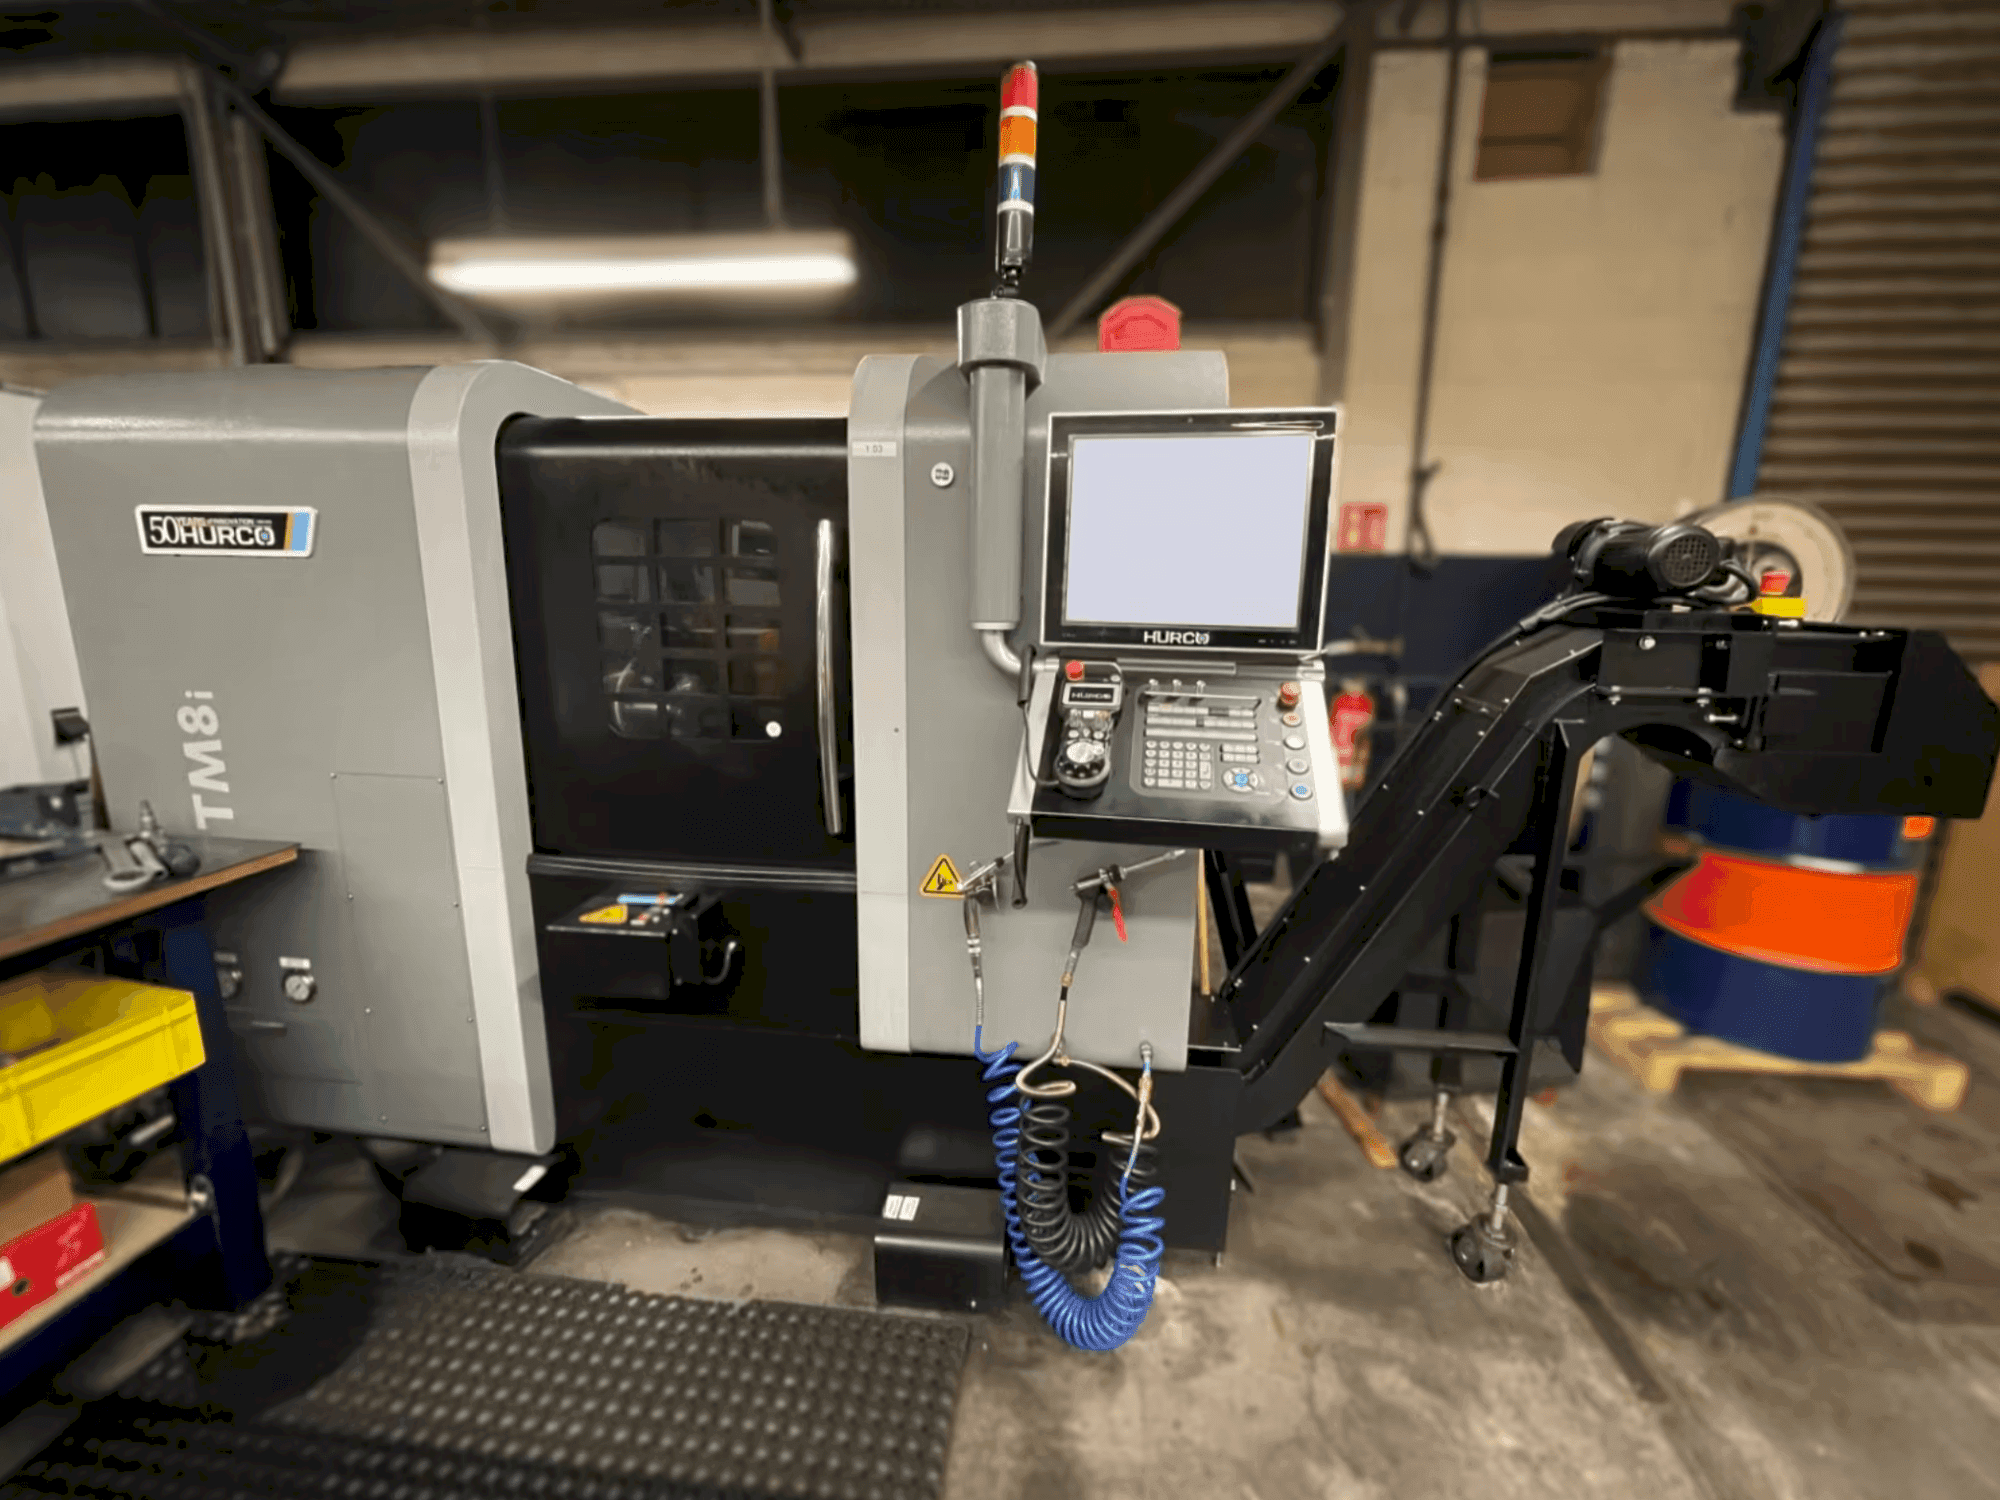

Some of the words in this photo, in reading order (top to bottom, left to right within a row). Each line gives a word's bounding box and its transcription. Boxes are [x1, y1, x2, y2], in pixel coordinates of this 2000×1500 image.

[149, 515, 180, 544] 50
[180, 525, 275, 546] HURCO
[1144, 630, 1210, 645] HURCO
[176, 690, 234, 830] TM8i
